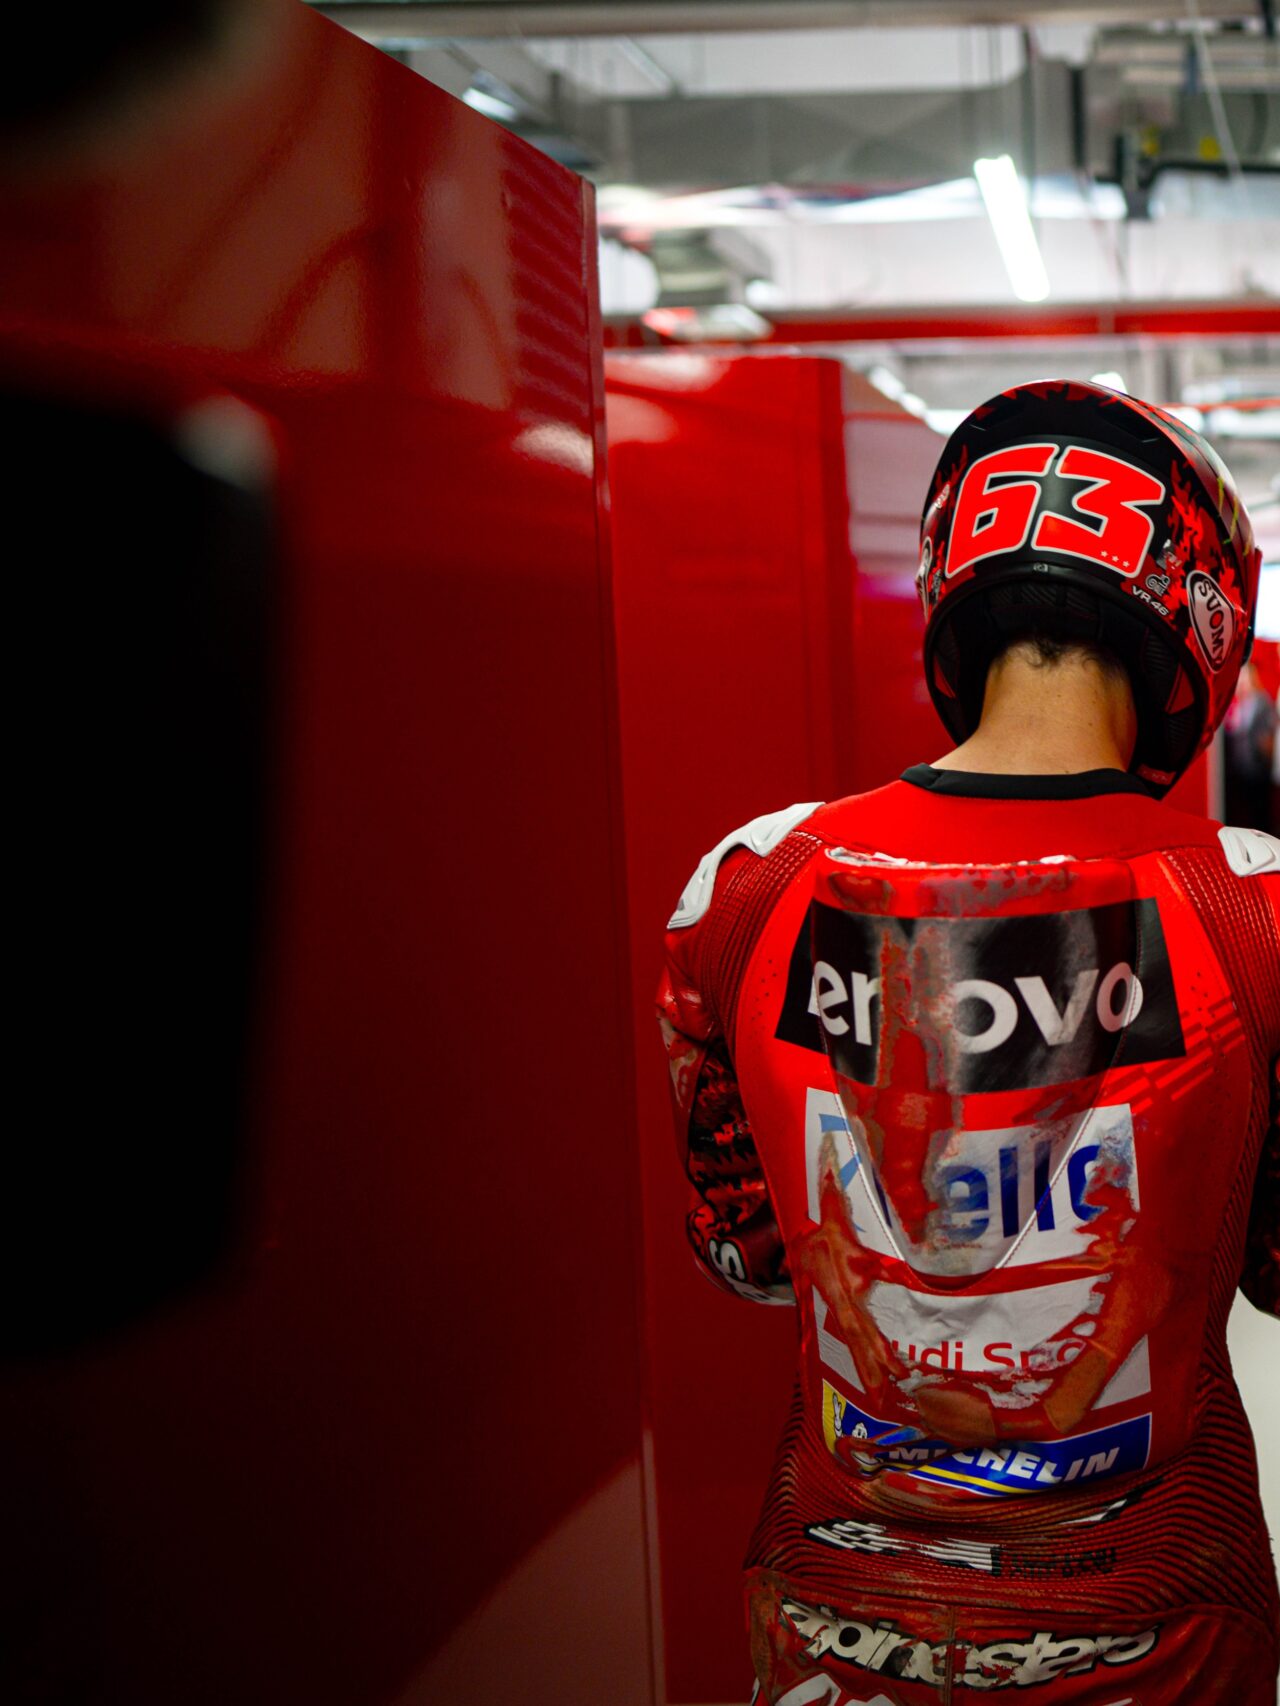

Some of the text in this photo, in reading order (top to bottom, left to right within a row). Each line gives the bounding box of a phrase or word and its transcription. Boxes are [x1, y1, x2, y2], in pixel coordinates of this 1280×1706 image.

[946, 443, 1167, 579] 63
[1198, 578, 1226, 666] SUOMY
[808, 960, 1144, 1055] enovo
